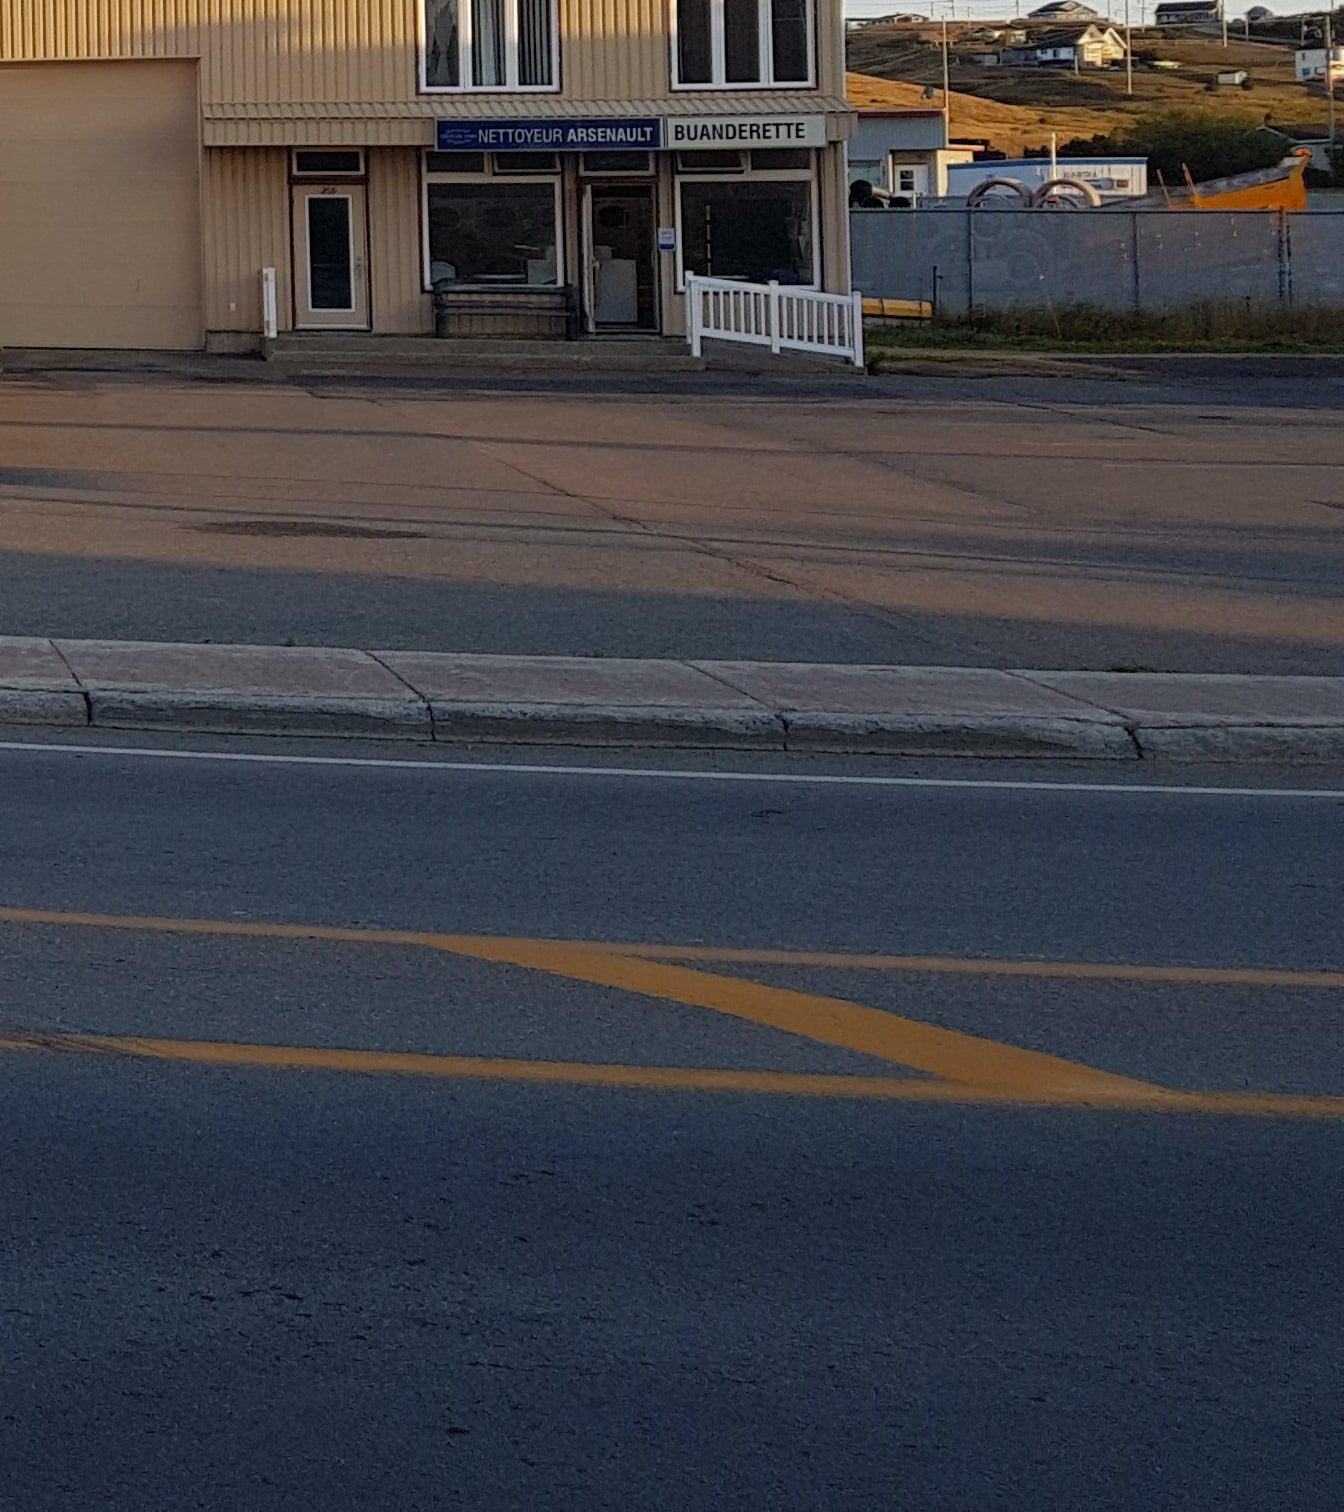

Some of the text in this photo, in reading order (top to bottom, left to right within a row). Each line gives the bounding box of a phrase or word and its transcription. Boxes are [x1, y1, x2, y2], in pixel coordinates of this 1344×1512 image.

[477, 128, 563, 144] NETTOYEUR
[567, 126, 654, 143] ARSENAULT
[674, 122, 806, 141] BUANDERETTE
